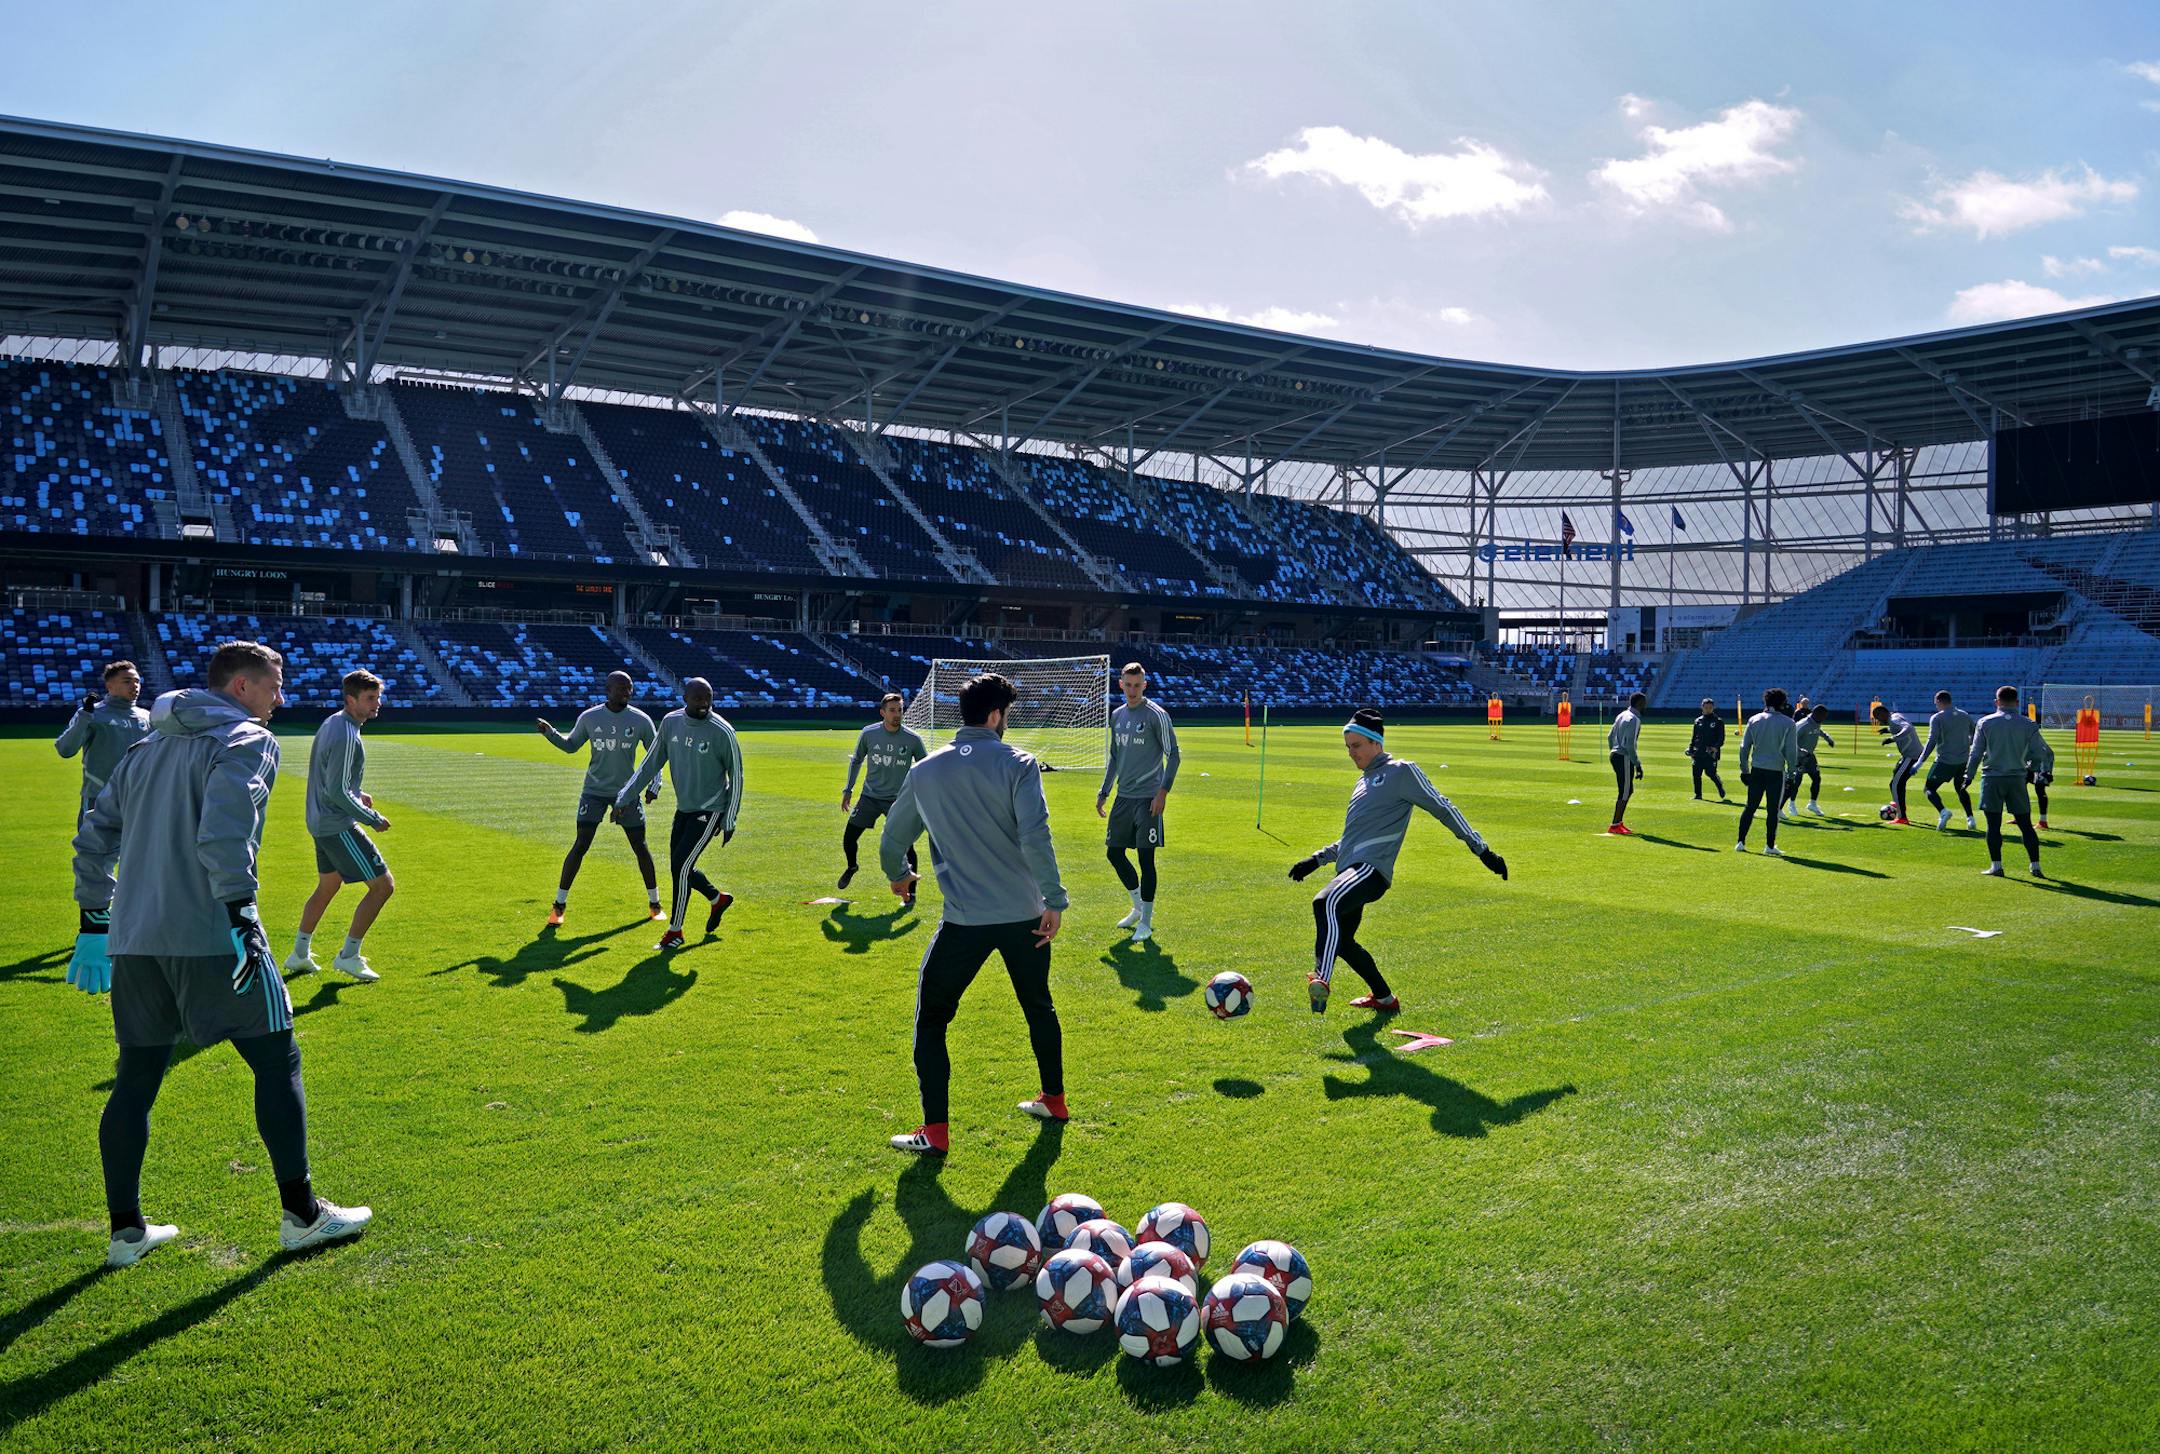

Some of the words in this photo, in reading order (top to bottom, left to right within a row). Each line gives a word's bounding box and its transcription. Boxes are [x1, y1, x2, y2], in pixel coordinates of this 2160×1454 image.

[1504, 539, 1634, 561] element
[216, 568, 257, 578] HUNGRY
[259, 571, 287, 579] LOON
[754, 593, 782, 601] HUNGRY
[611, 726, 616, 735] 3
[685, 736, 693, 747] 12
[1133, 737, 1145, 745] MN
[1149, 828, 1157, 843] 8
